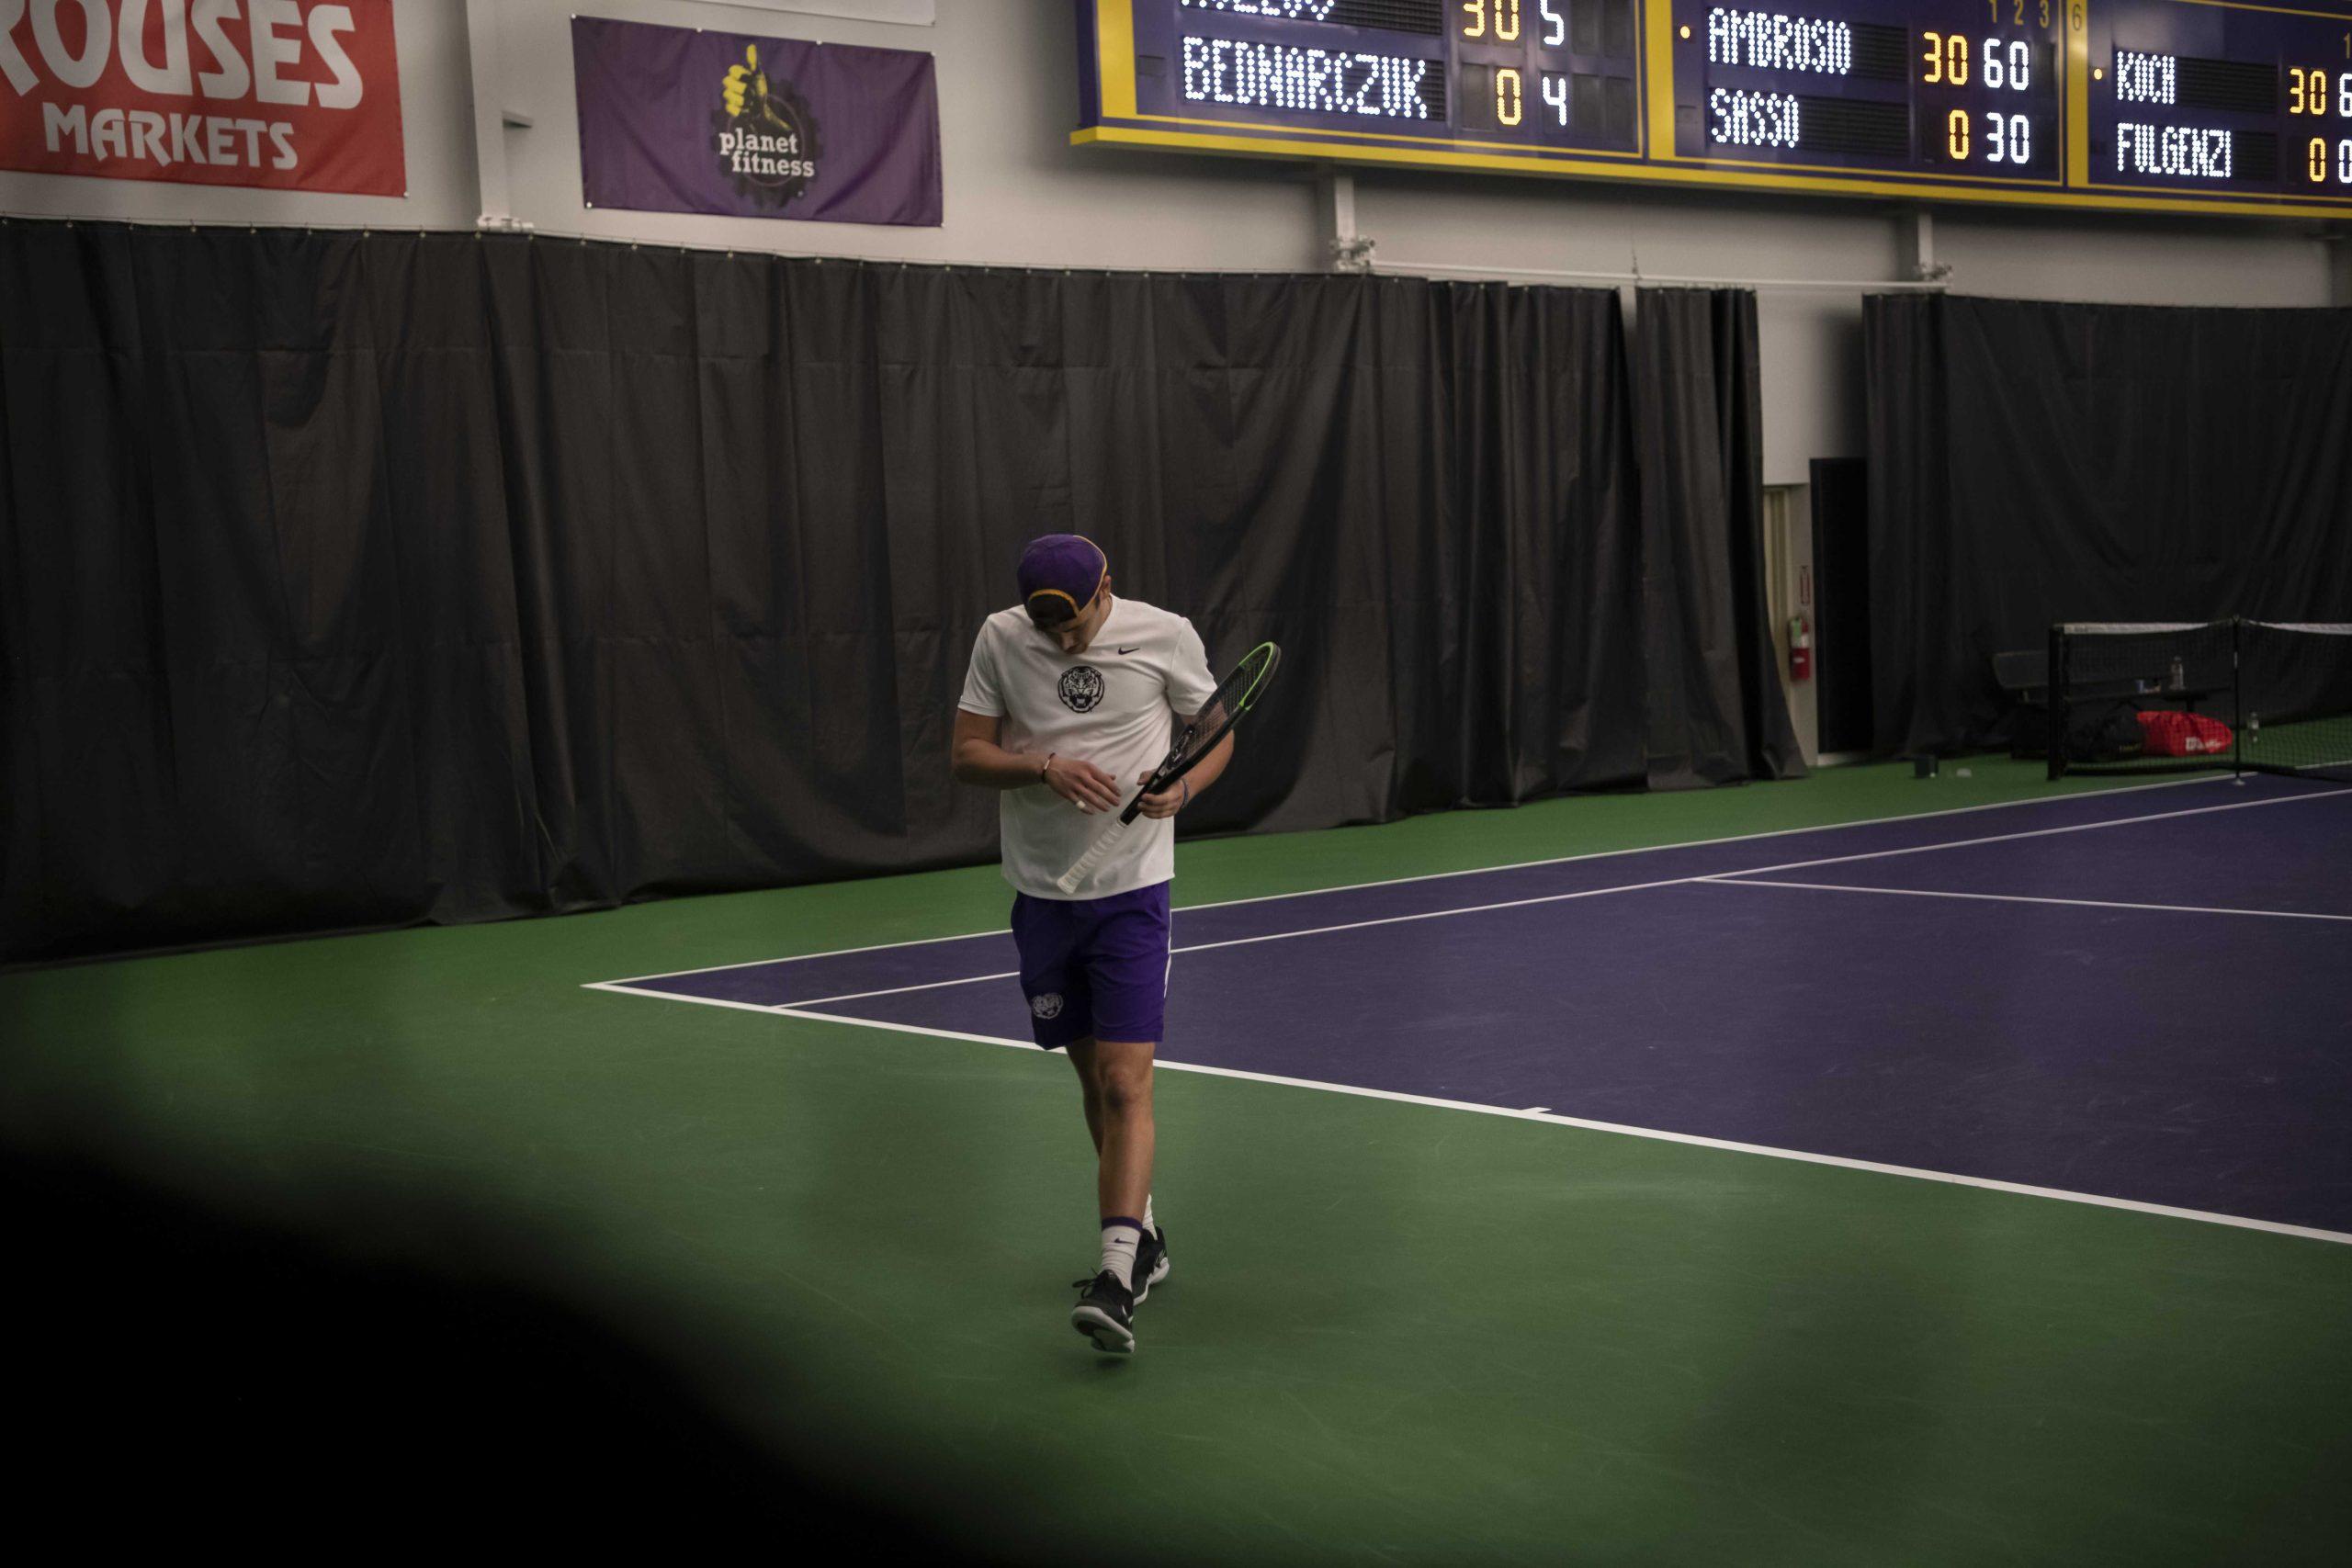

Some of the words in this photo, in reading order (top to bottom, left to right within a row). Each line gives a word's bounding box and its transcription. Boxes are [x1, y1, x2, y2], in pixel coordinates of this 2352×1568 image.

[2040, 0, 2049, 28] 3
[2073, 4, 2081, 31] 6
[1709, 7, 1851, 74] AMBROSIO
[1923, 31, 1968, 85] 30
[1182, 36, 1428, 119] BEDNARCZUK
[1496, 69, 1521, 126] 0
[1542, 76, 1566, 126] 4
[2117, 51, 2176, 104] KOCH
[2290, 68, 2326, 115] 30
[42, 102, 298, 170] MARKETS
[718, 127, 797, 155] planet
[1710, 87, 1800, 148] SASSO
[1949, 109, 1970, 160] 0
[2117, 122, 2232, 177] FULGENZI
[2309, 138, 2326, 182] 0
[731, 150, 814, 176] fitness
